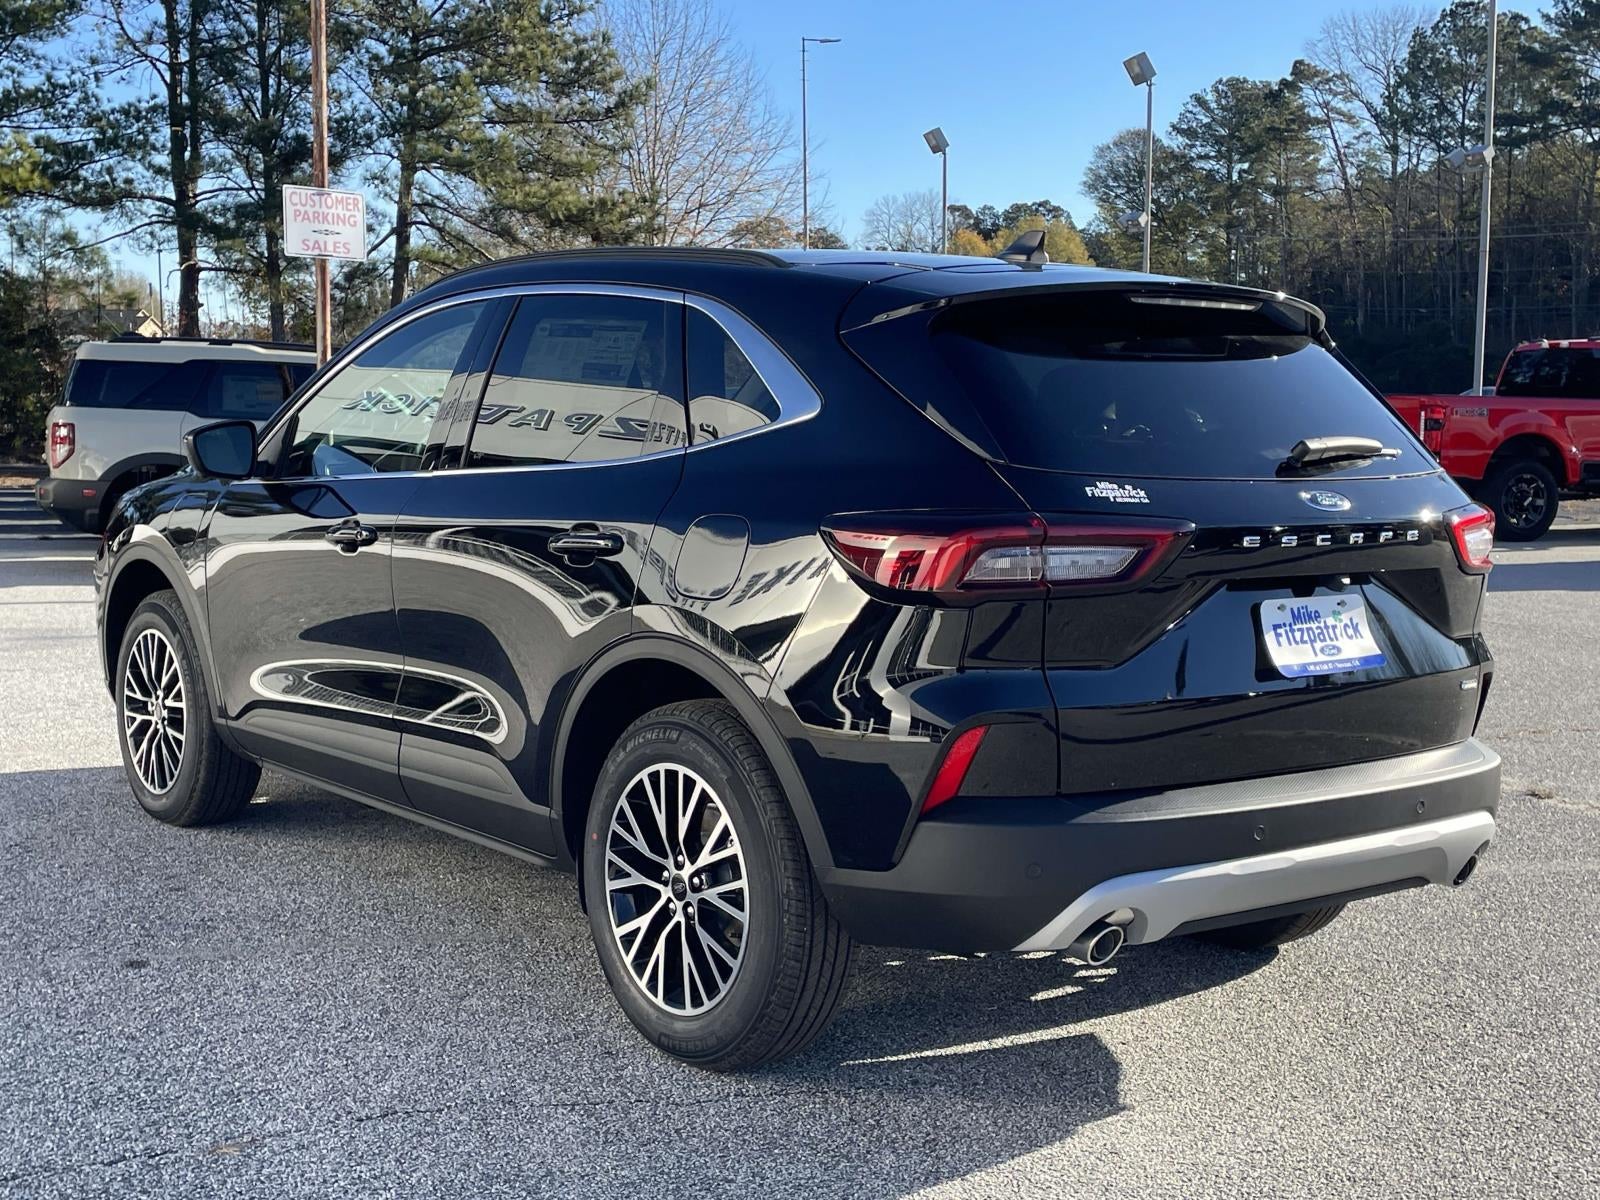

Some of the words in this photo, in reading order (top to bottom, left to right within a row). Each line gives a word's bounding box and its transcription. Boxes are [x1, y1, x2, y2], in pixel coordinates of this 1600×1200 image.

[289, 191, 360, 212] CUSTOMER
[293, 208, 358, 228] PARKING
[301, 238, 351, 255] SALES
[1085, 486, 1147, 502] Fitzpatrick
[1243, 529, 1419, 548] ESCAPE
[1290, 604, 1321, 626] Mike
[1272, 617, 1364, 657] Fitzpatrick
[625, 728, 680, 752] MICHELIN
